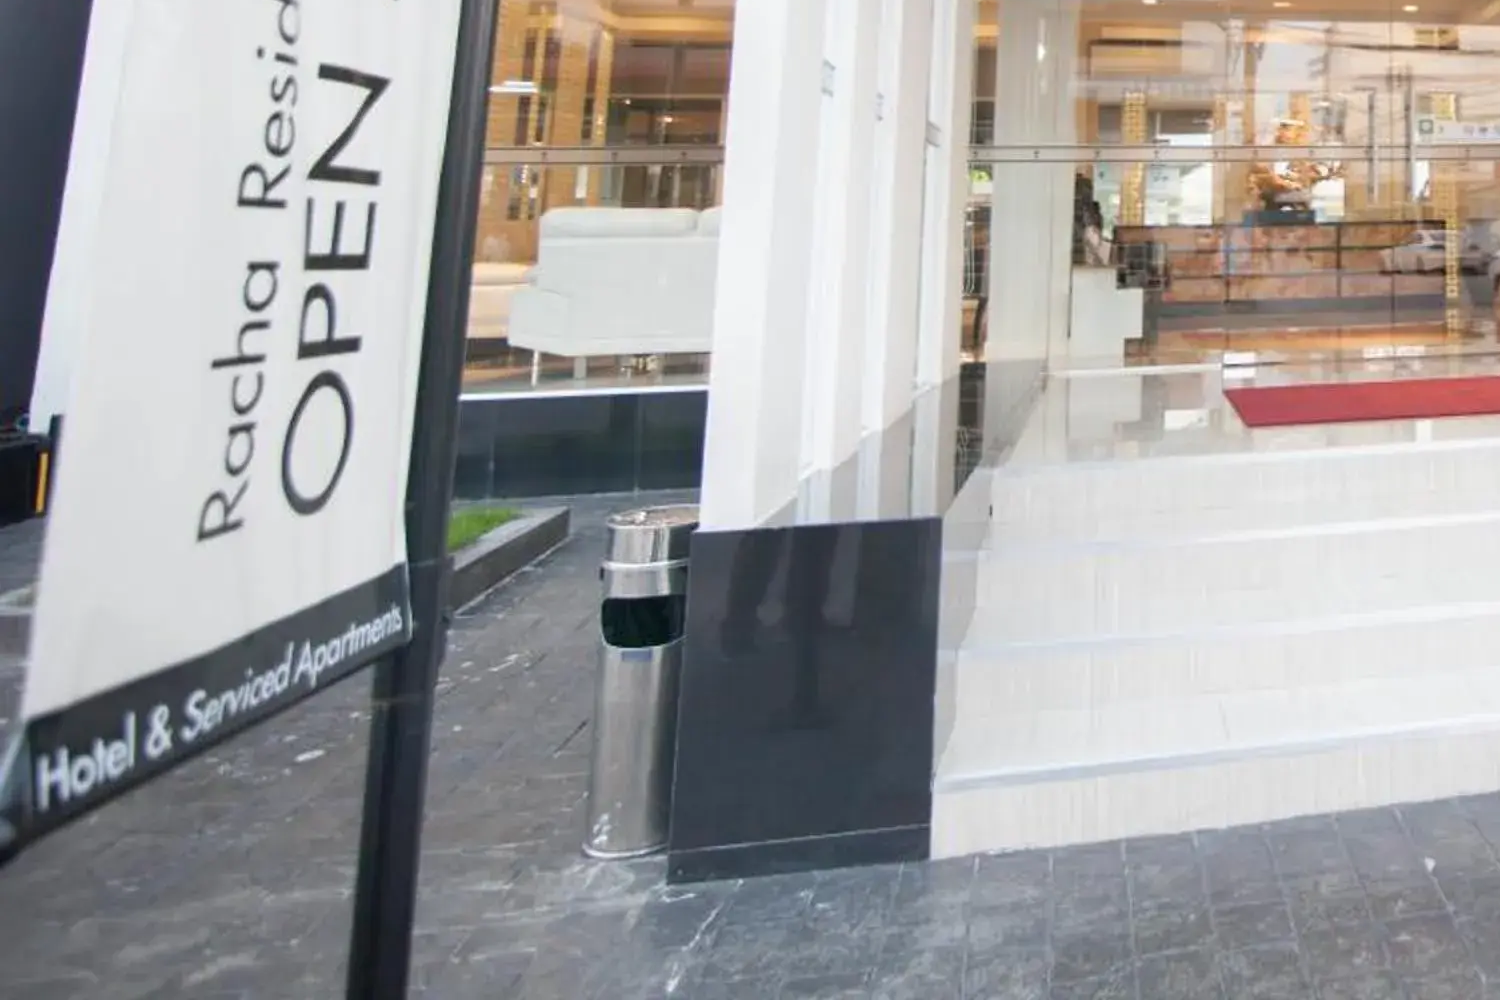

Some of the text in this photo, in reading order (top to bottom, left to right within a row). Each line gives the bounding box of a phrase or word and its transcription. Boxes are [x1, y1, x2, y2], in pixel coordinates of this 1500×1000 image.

[196, 260, 280, 544] Racha
[281, 62, 392, 517] OPEN
[36, 604, 404, 812] Hotel & Serviced Apartments
